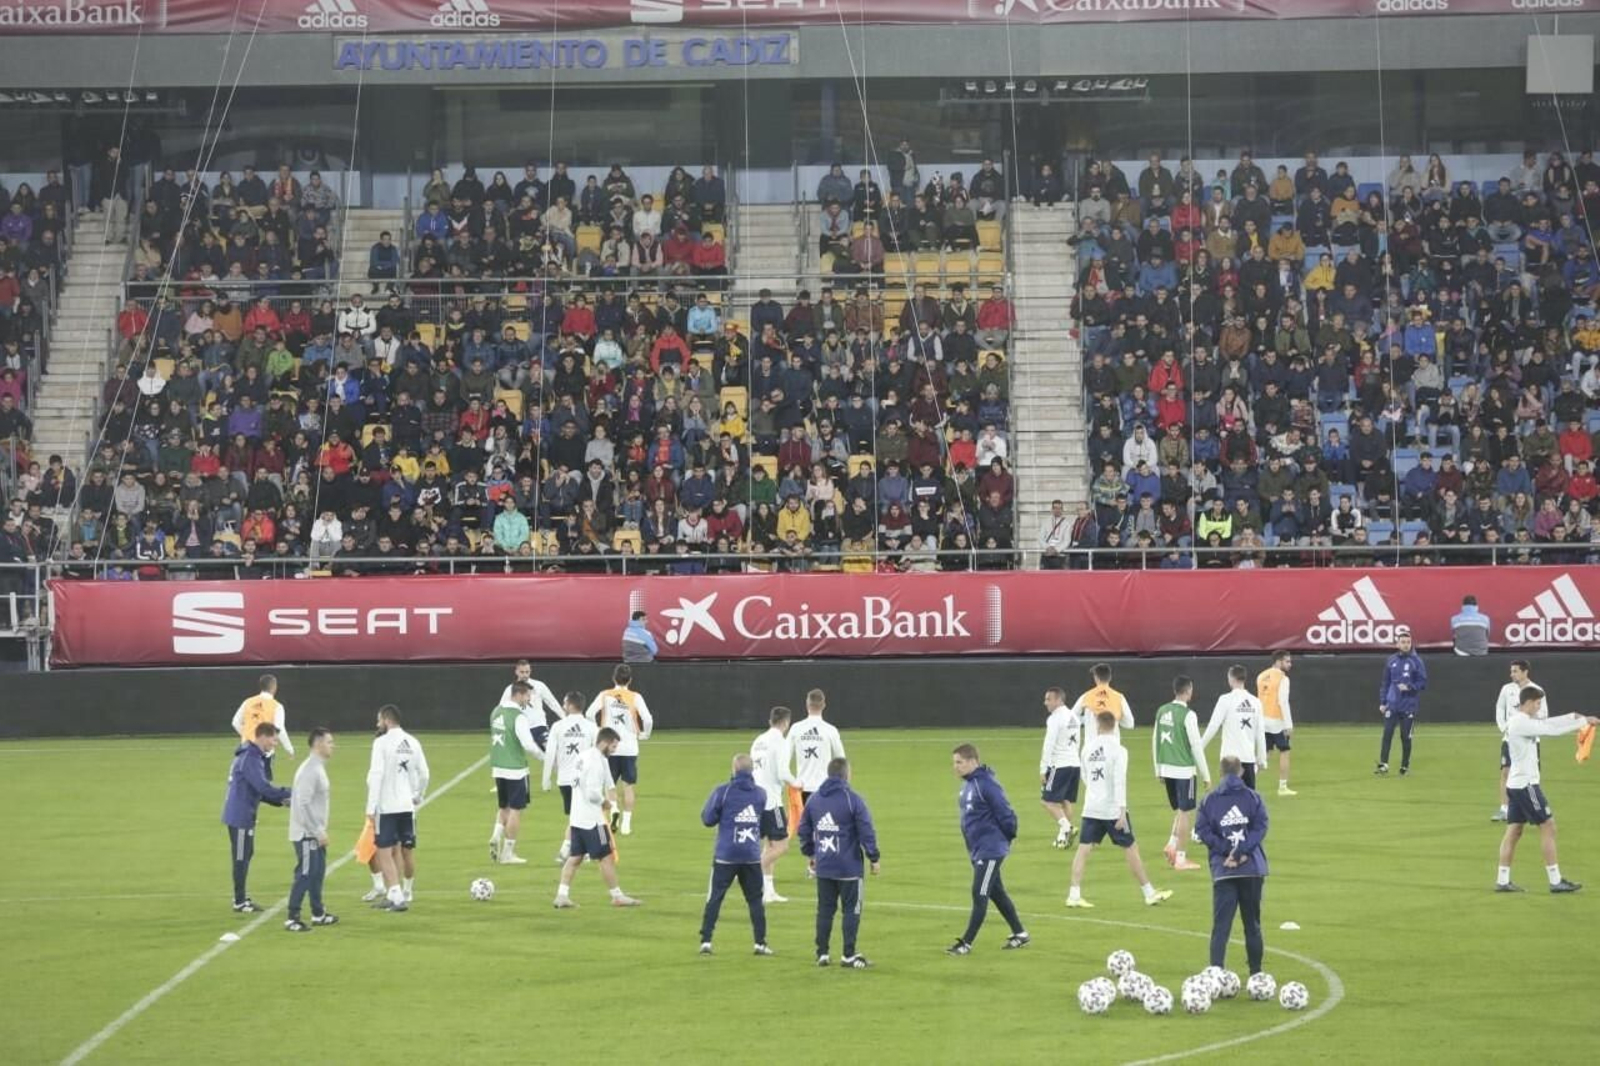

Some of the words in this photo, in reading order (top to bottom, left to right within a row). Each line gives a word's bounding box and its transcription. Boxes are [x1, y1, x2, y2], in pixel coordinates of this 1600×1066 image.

[0, 0, 143, 25] aixaBank
[298, 11, 368, 29] adidas
[430, 10, 501, 28] adidas
[337, 37, 608, 70] AYUNTAMIENTO
[623, 38, 668, 68] DE
[268, 606, 453, 636] SEAT
[732, 593, 971, 642] CaixaBank
